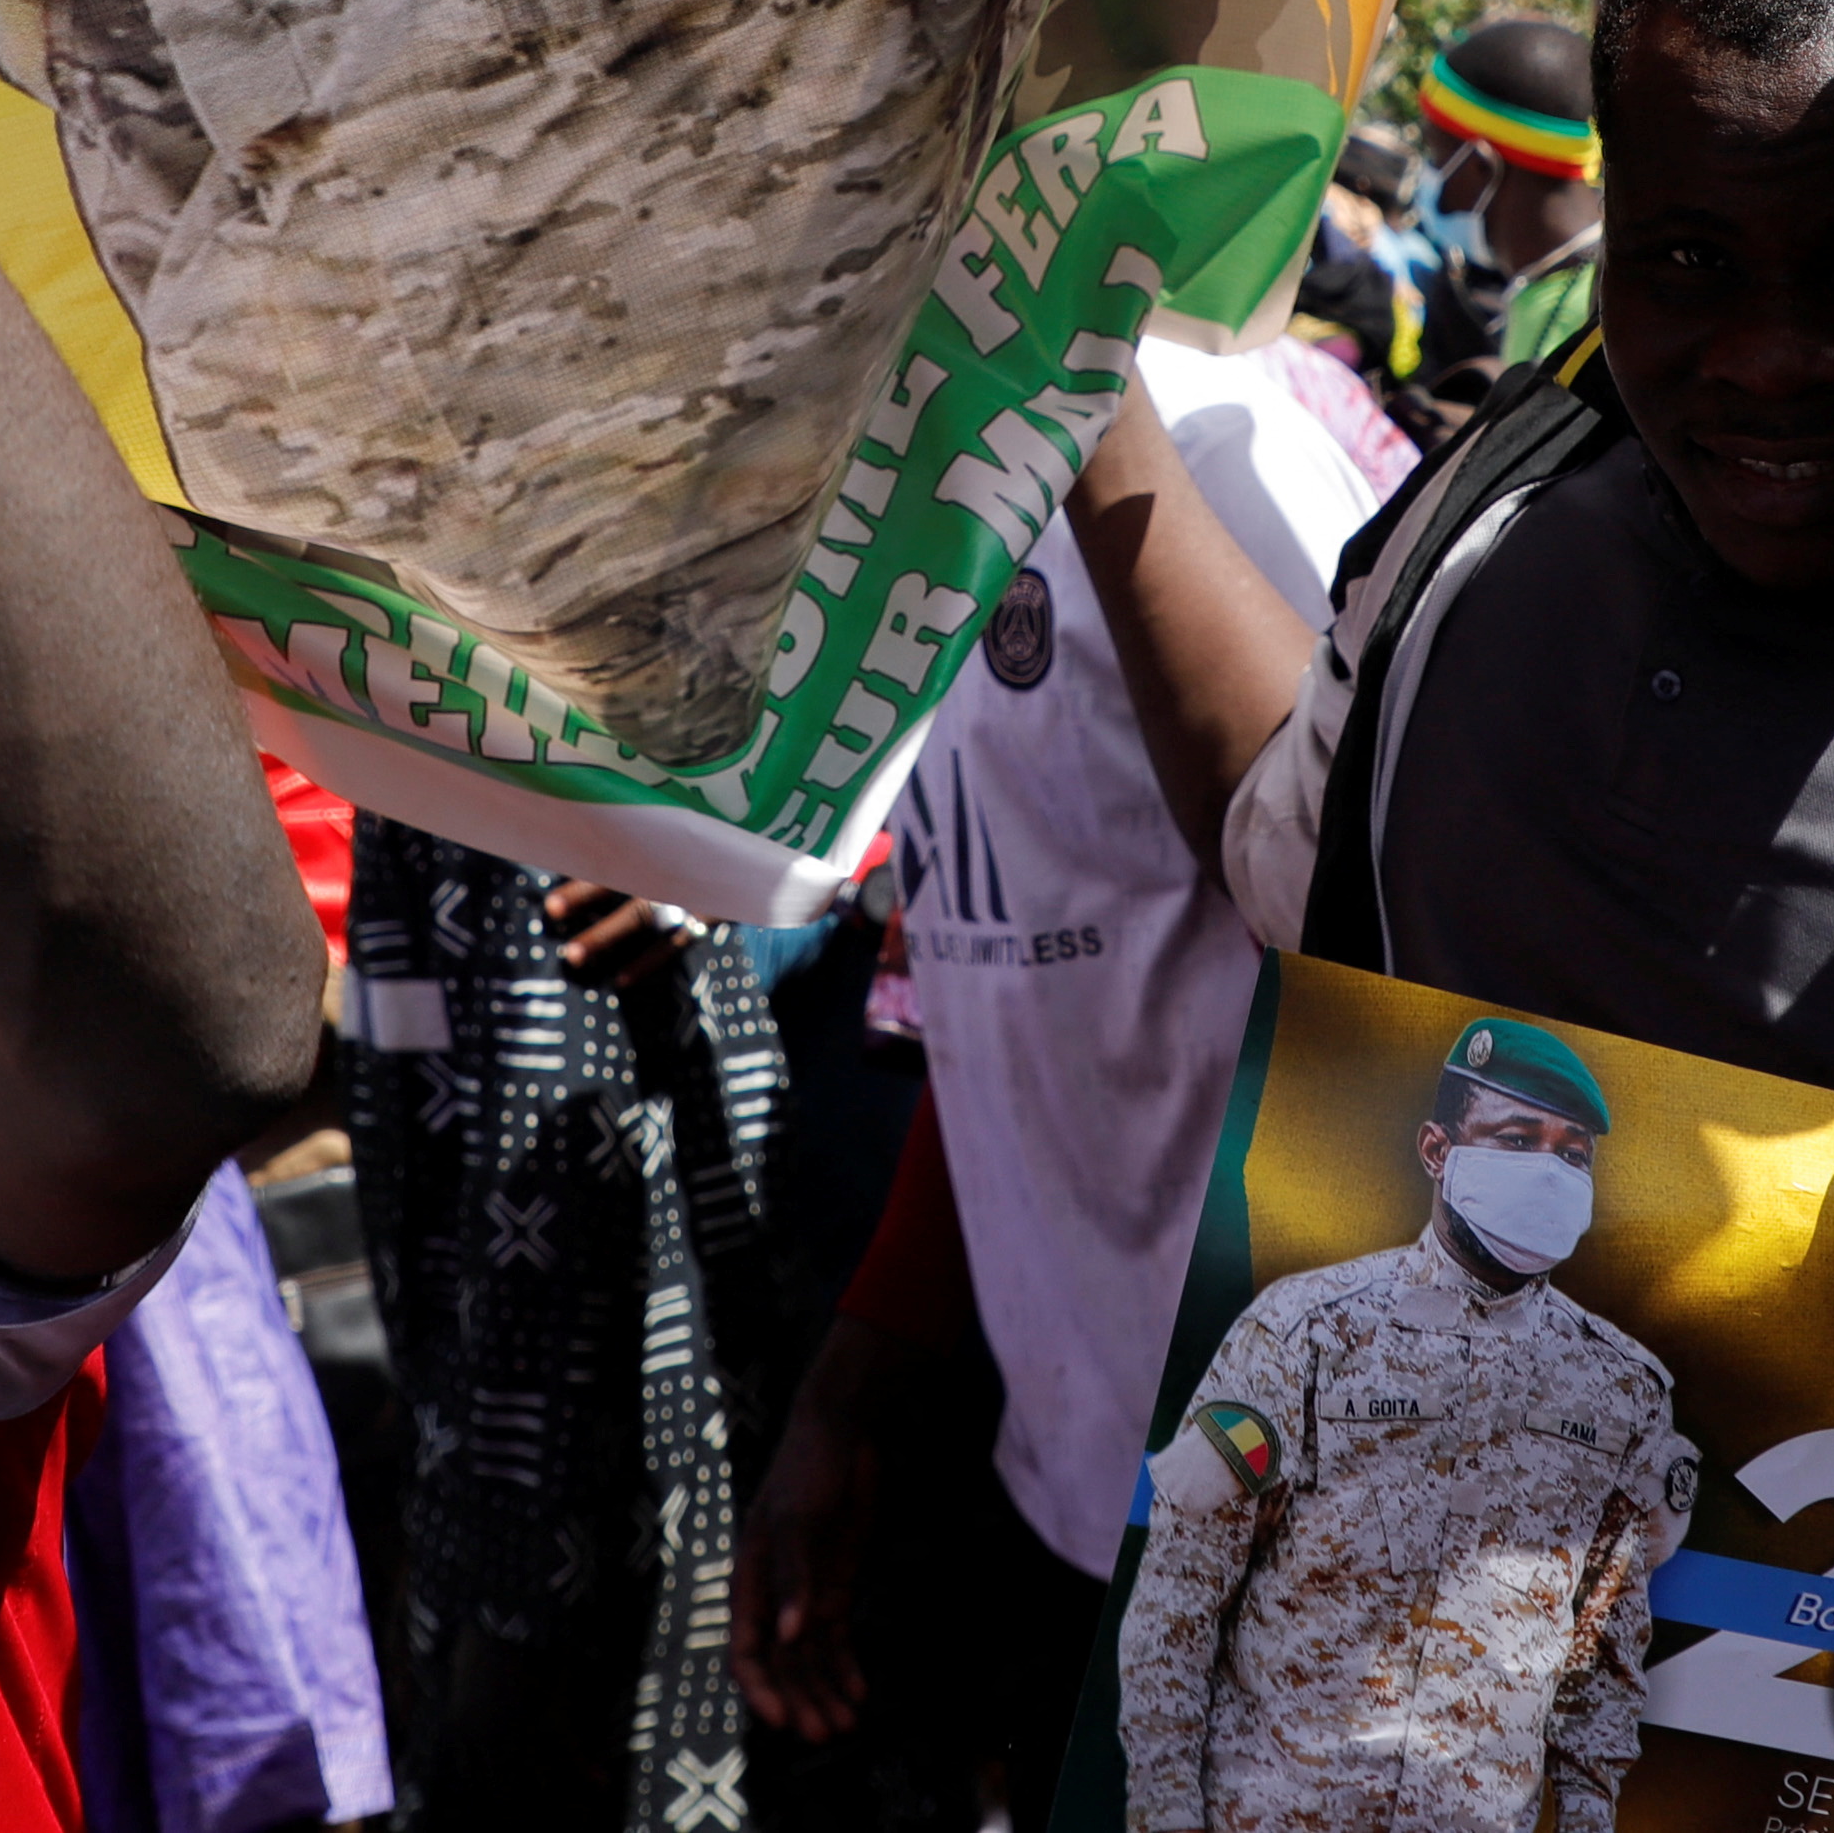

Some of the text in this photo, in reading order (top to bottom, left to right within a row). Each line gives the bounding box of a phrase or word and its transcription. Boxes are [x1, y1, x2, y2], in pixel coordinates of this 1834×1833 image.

[931, 76, 1210, 359] FERA
[1368, 1397, 1421, 1418] GOITA
[1560, 1419, 1598, 1445] FAMA
